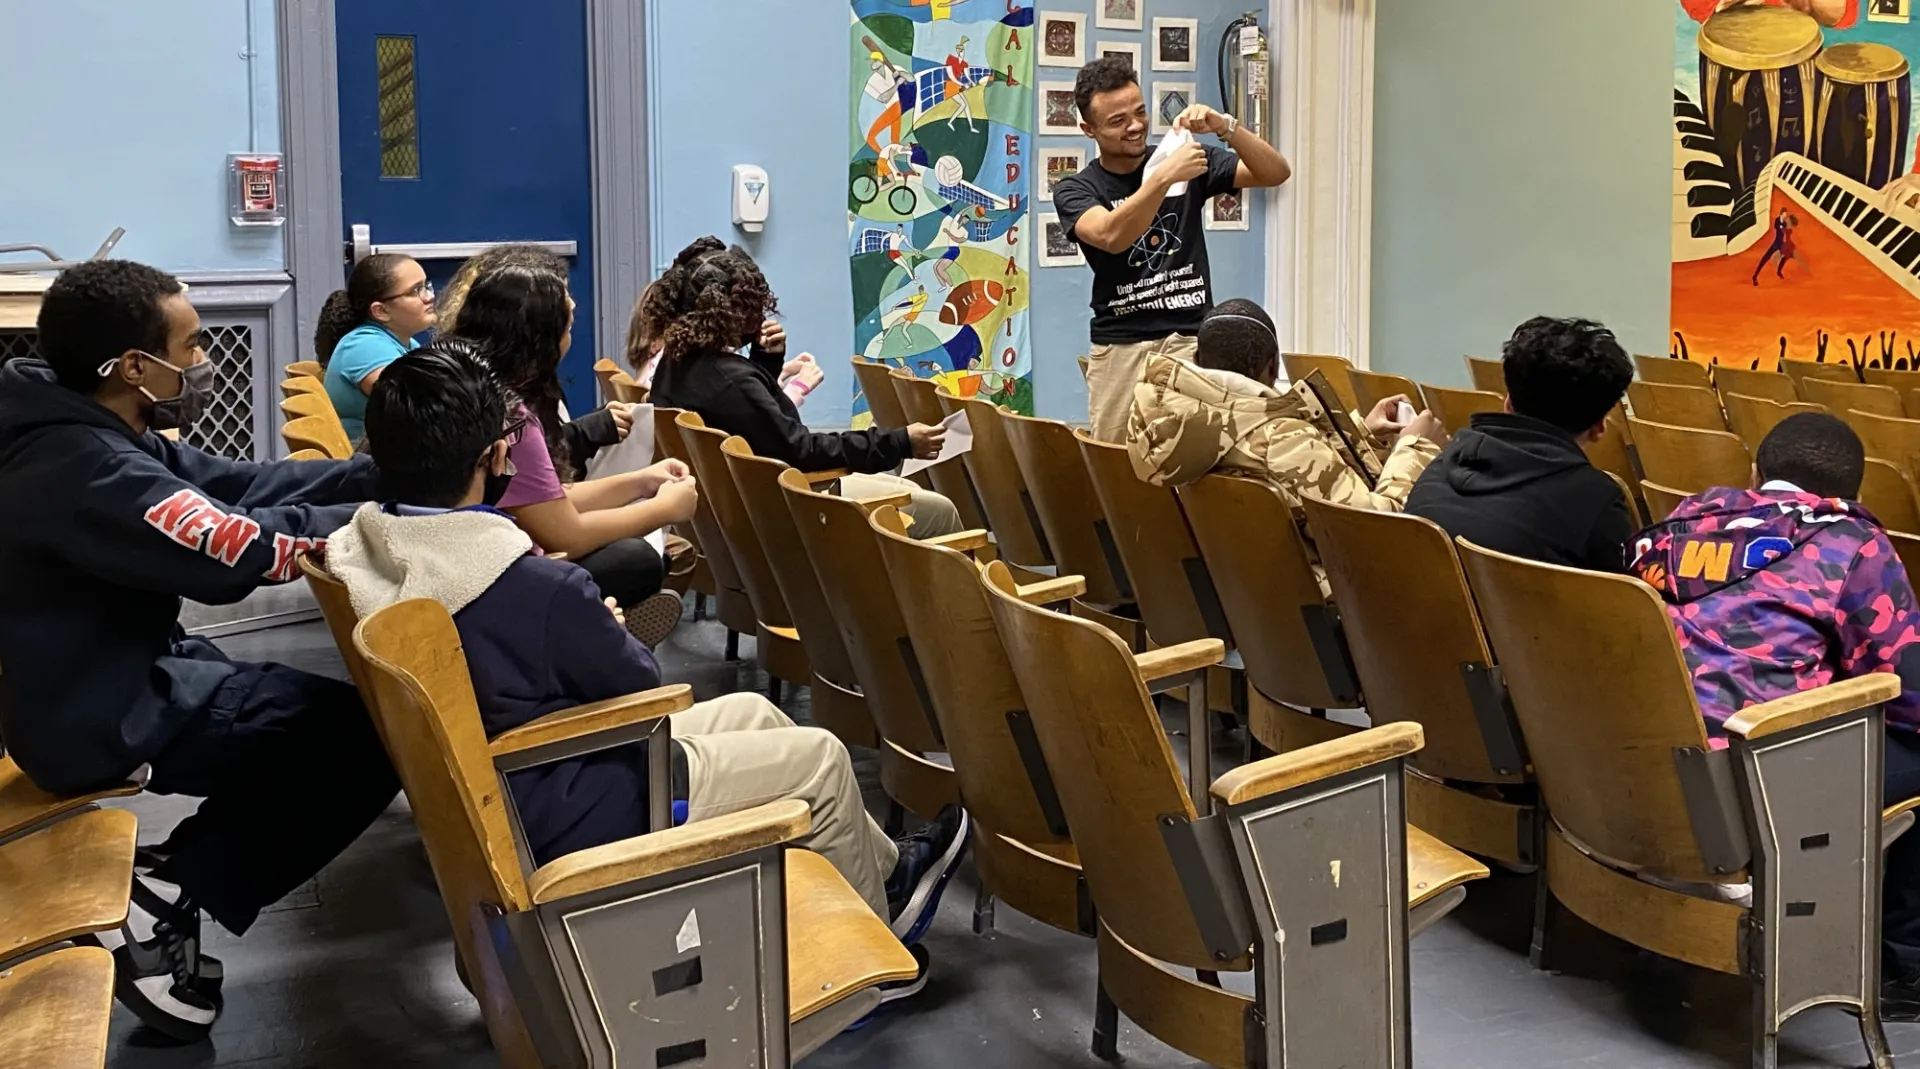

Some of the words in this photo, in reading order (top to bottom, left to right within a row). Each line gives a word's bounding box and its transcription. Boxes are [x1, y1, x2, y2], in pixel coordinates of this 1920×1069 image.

[248, 174, 271, 182] FIRE
[1002, 134, 1021, 398] EDUCATION
[1117, 283, 1133, 296] Until
[1137, 287, 1158, 299] speed
[1164, 281, 1180, 294] light
[1180, 275, 1204, 289] squared
[1165, 290, 1206, 310] ENERGY
[144, 488, 260, 567] NEW
